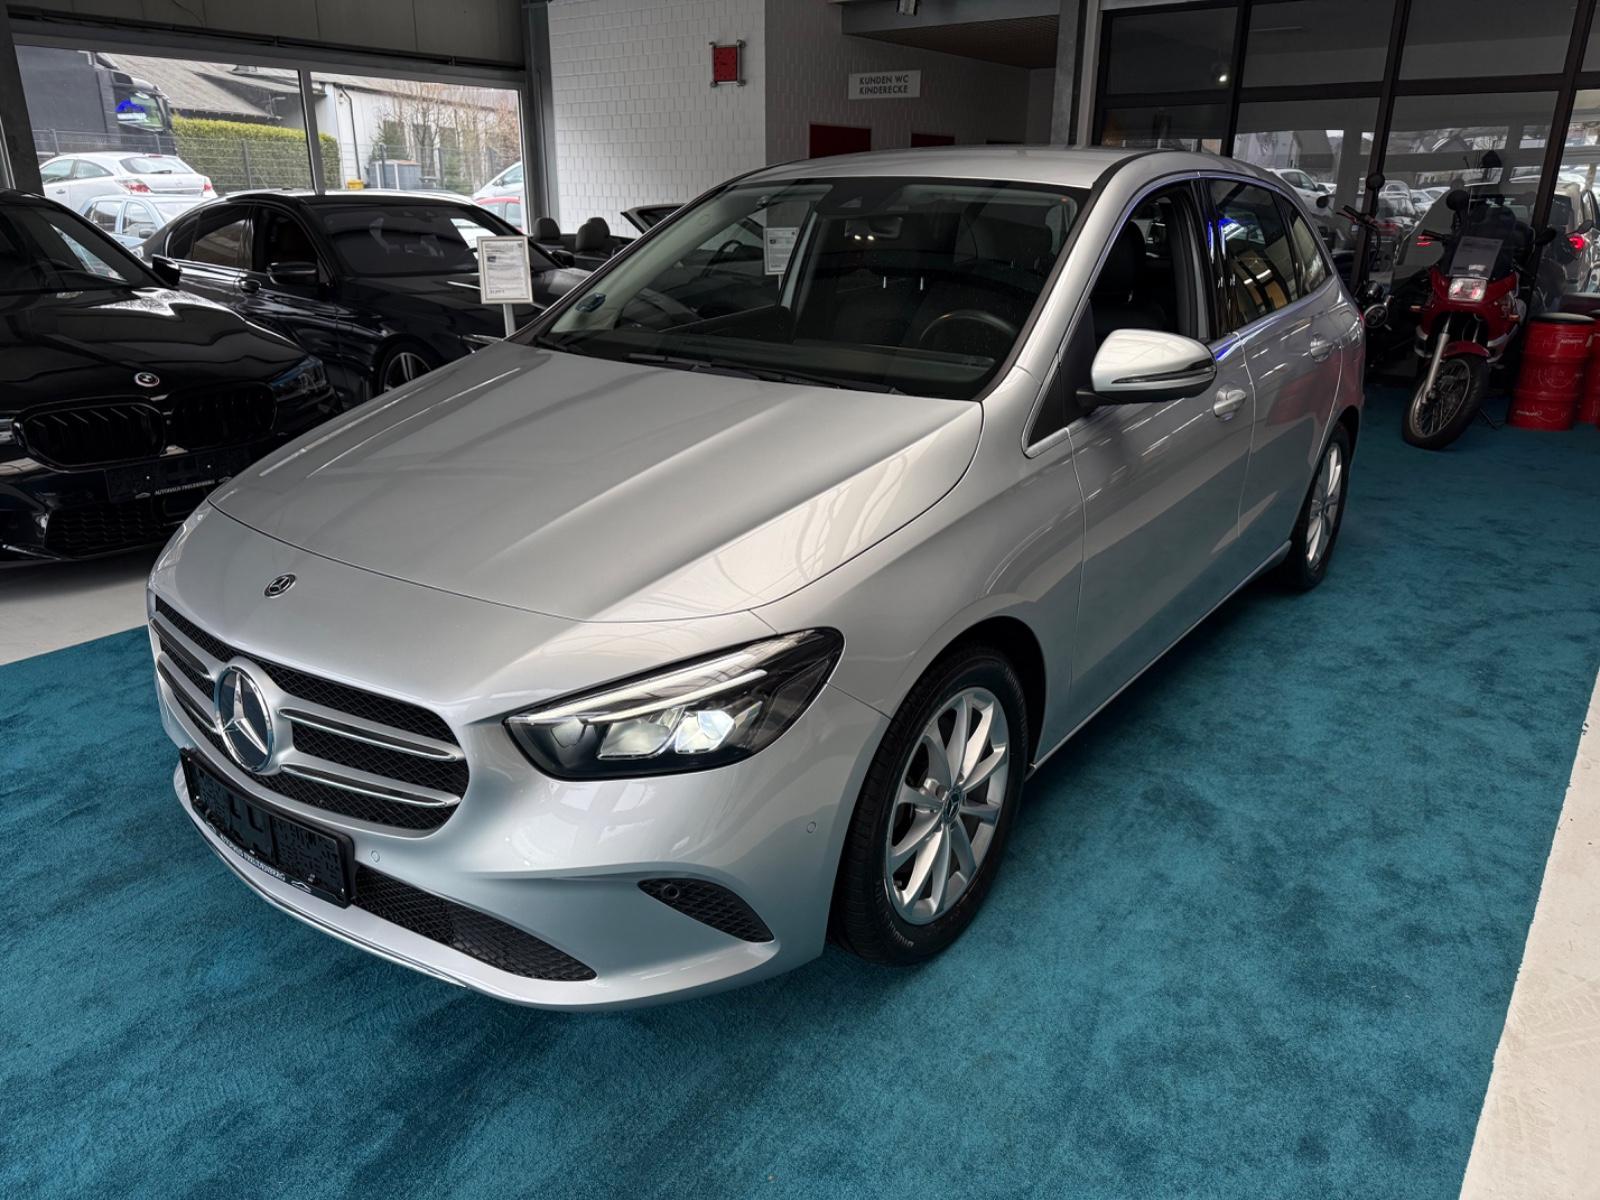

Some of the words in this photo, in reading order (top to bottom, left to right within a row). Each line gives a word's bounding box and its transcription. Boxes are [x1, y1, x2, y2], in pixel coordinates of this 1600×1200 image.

[859, 75, 892, 85] KUNDEN
[894, 74, 909, 84] WC
[859, 84, 908, 95] KINDERECKE
